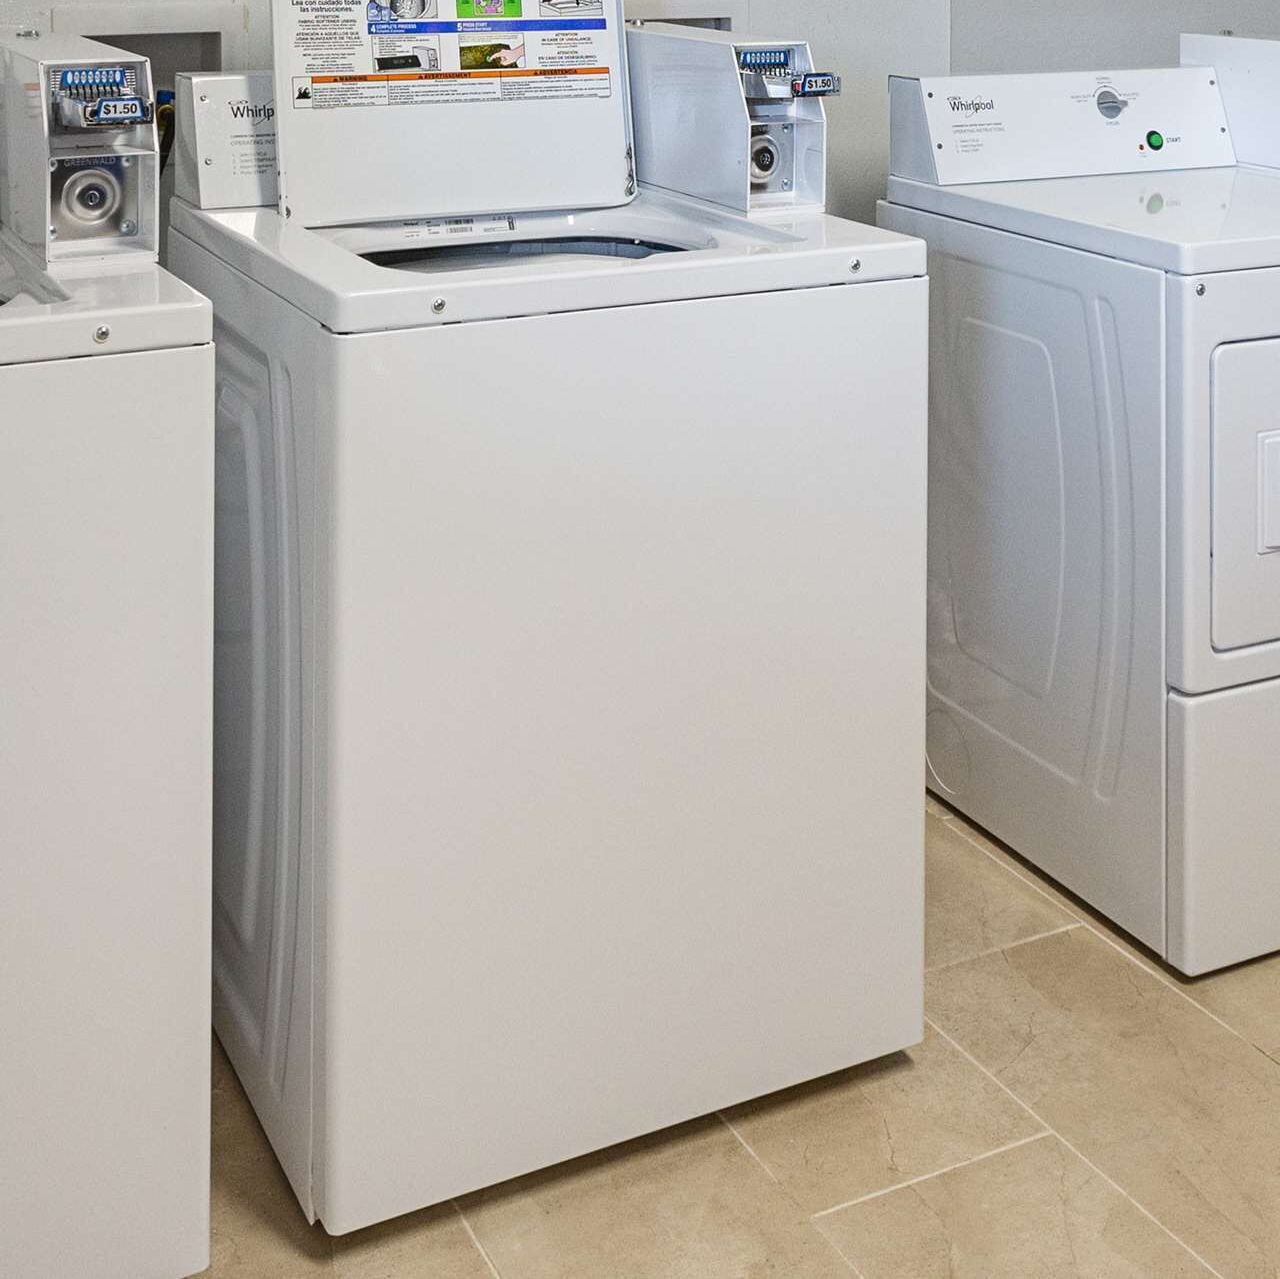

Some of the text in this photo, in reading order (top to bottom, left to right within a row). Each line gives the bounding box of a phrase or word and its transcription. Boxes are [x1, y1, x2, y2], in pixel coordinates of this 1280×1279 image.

[370, 25, 376, 33] 4
[457, 23, 462, 31] 5
[808, 78, 832, 89] $1.50
[103, 103, 138, 115] $1.50
[948, 99, 994, 113] Whirlpool
[231, 105, 275, 121] Whirlp
[64, 157, 116, 167] GREENWALD
